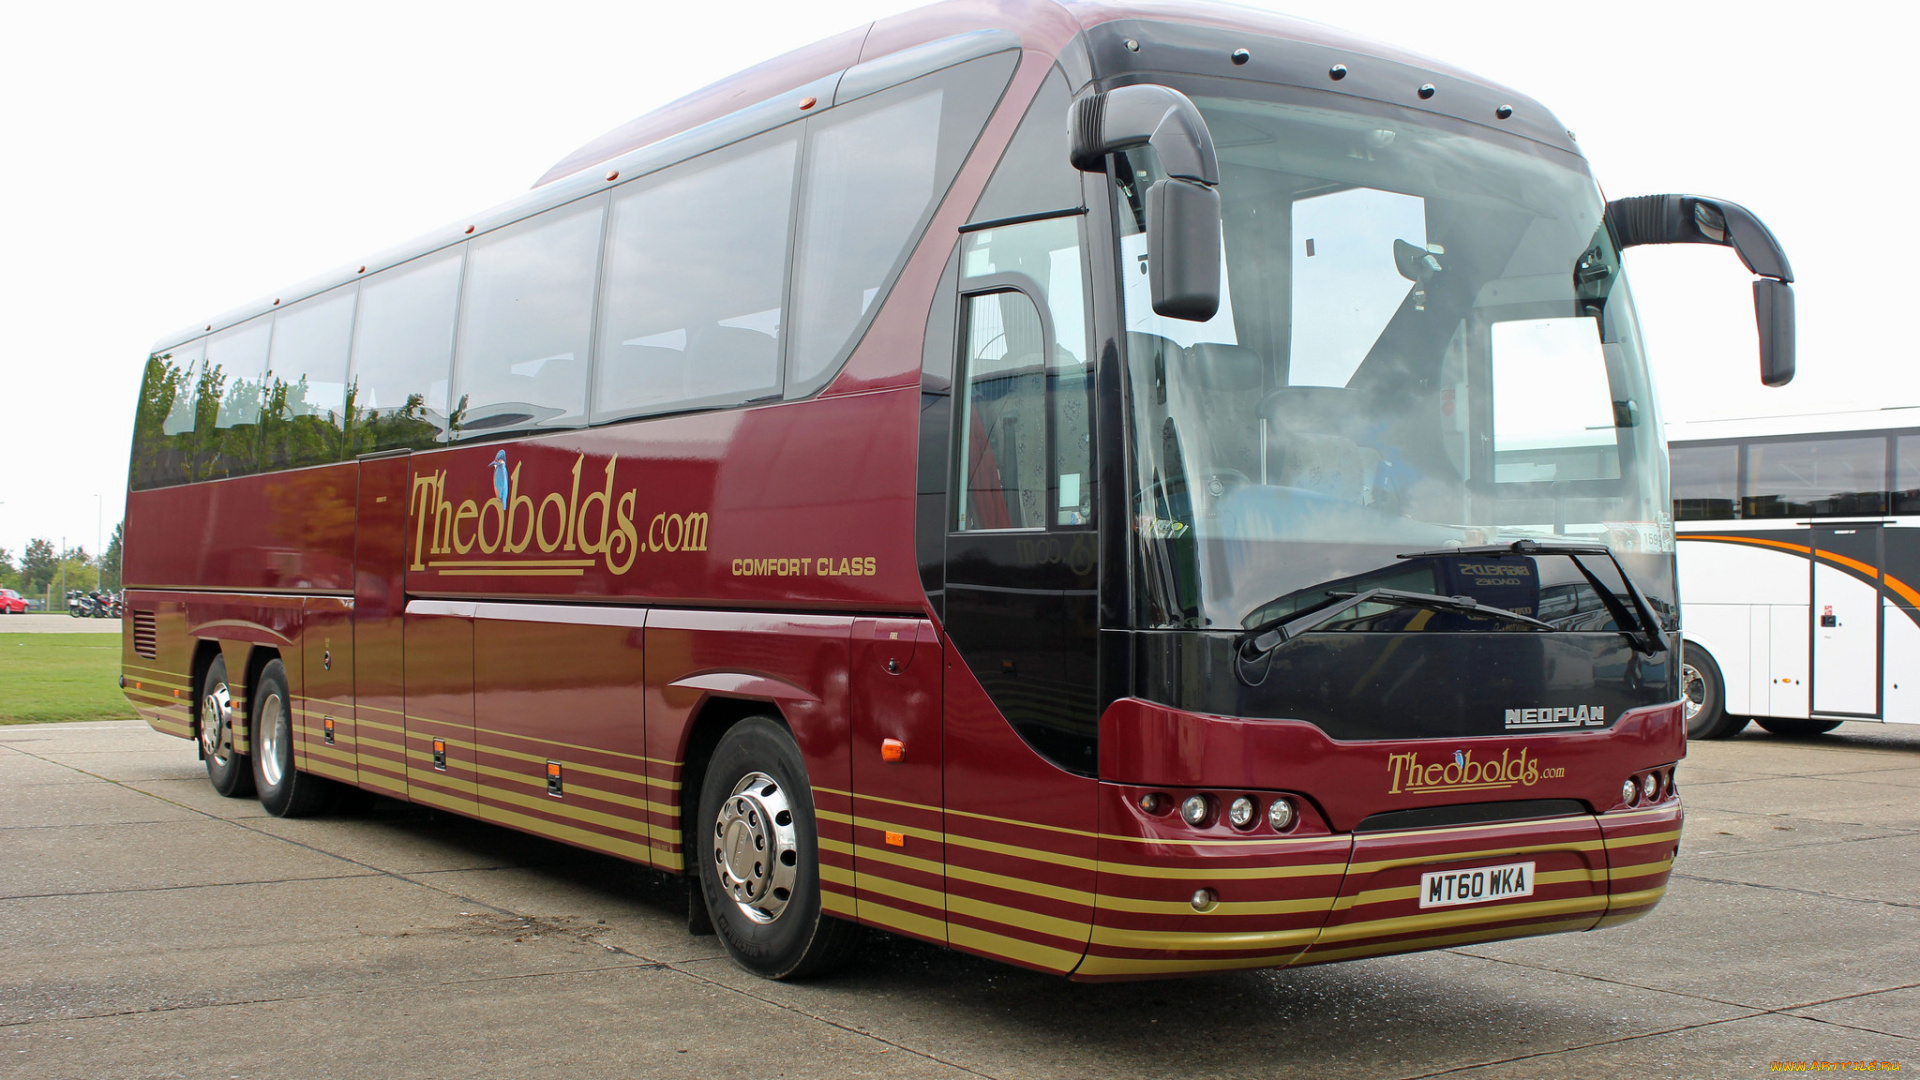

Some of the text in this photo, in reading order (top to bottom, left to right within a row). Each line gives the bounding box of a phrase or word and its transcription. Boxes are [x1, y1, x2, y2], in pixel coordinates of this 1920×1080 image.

[410, 451, 708, 576] Theobolds.com
[732, 556, 876, 577] COMFORT CLASS
[1505, 704, 1604, 728] NEOPLAN
[1387, 747, 1565, 794] Theobolds.com
[1429, 867, 1525, 902] MT60 WKA
